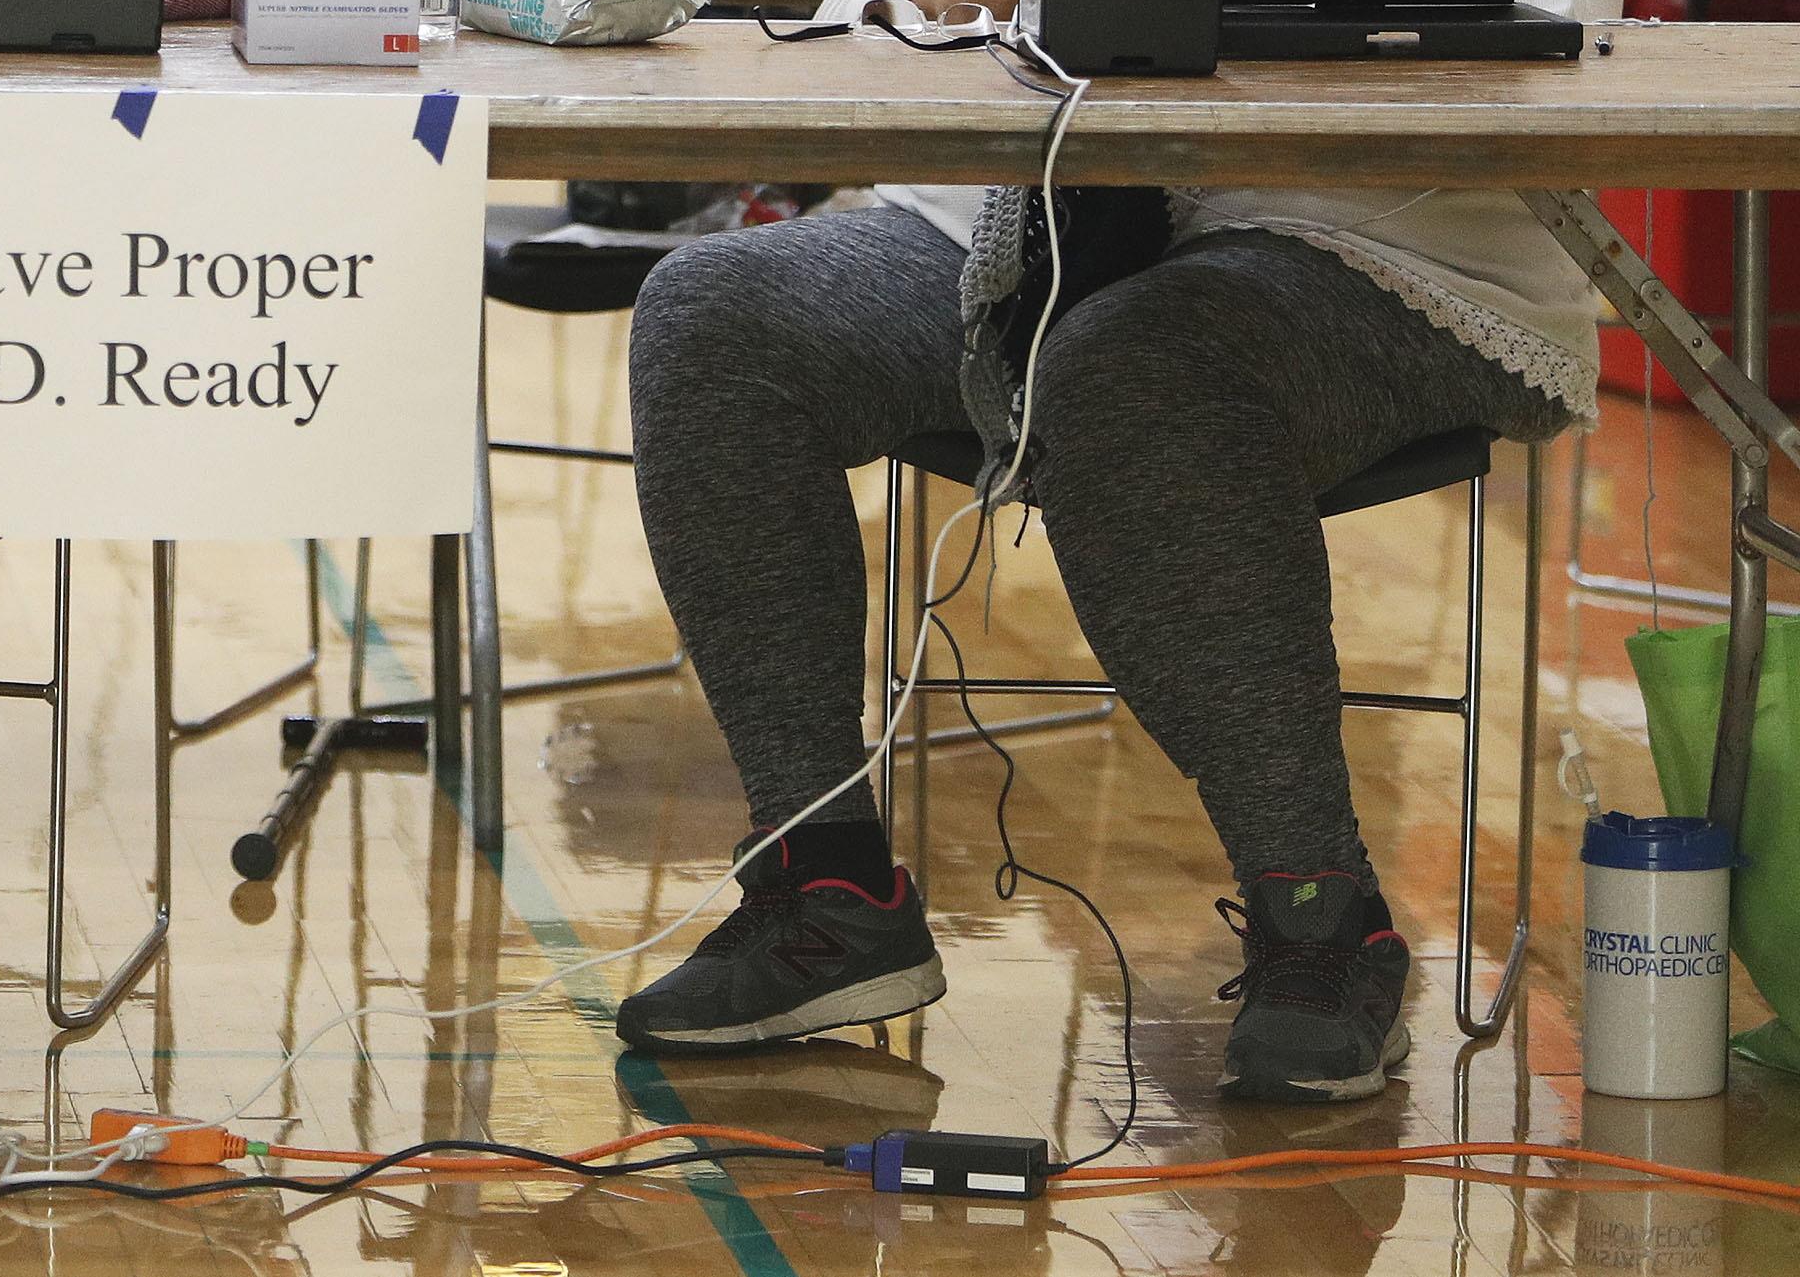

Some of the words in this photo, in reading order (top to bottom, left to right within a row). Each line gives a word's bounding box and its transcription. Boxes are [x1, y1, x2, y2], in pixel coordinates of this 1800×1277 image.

[290, 5, 320, 13] NITRILE
[322, 5, 376, 13] EXAMINATION
[378, 5, 409, 13] GLOVES
[508, 12, 543, 38] WIPES
[392, 36, 400, 51] L
[121, 233, 373, 319] Proper
[99, 340, 340, 427] Ready
[1584, 927, 1655, 954] CRYSTAL
[1660, 933, 1719, 954] CLINIC
